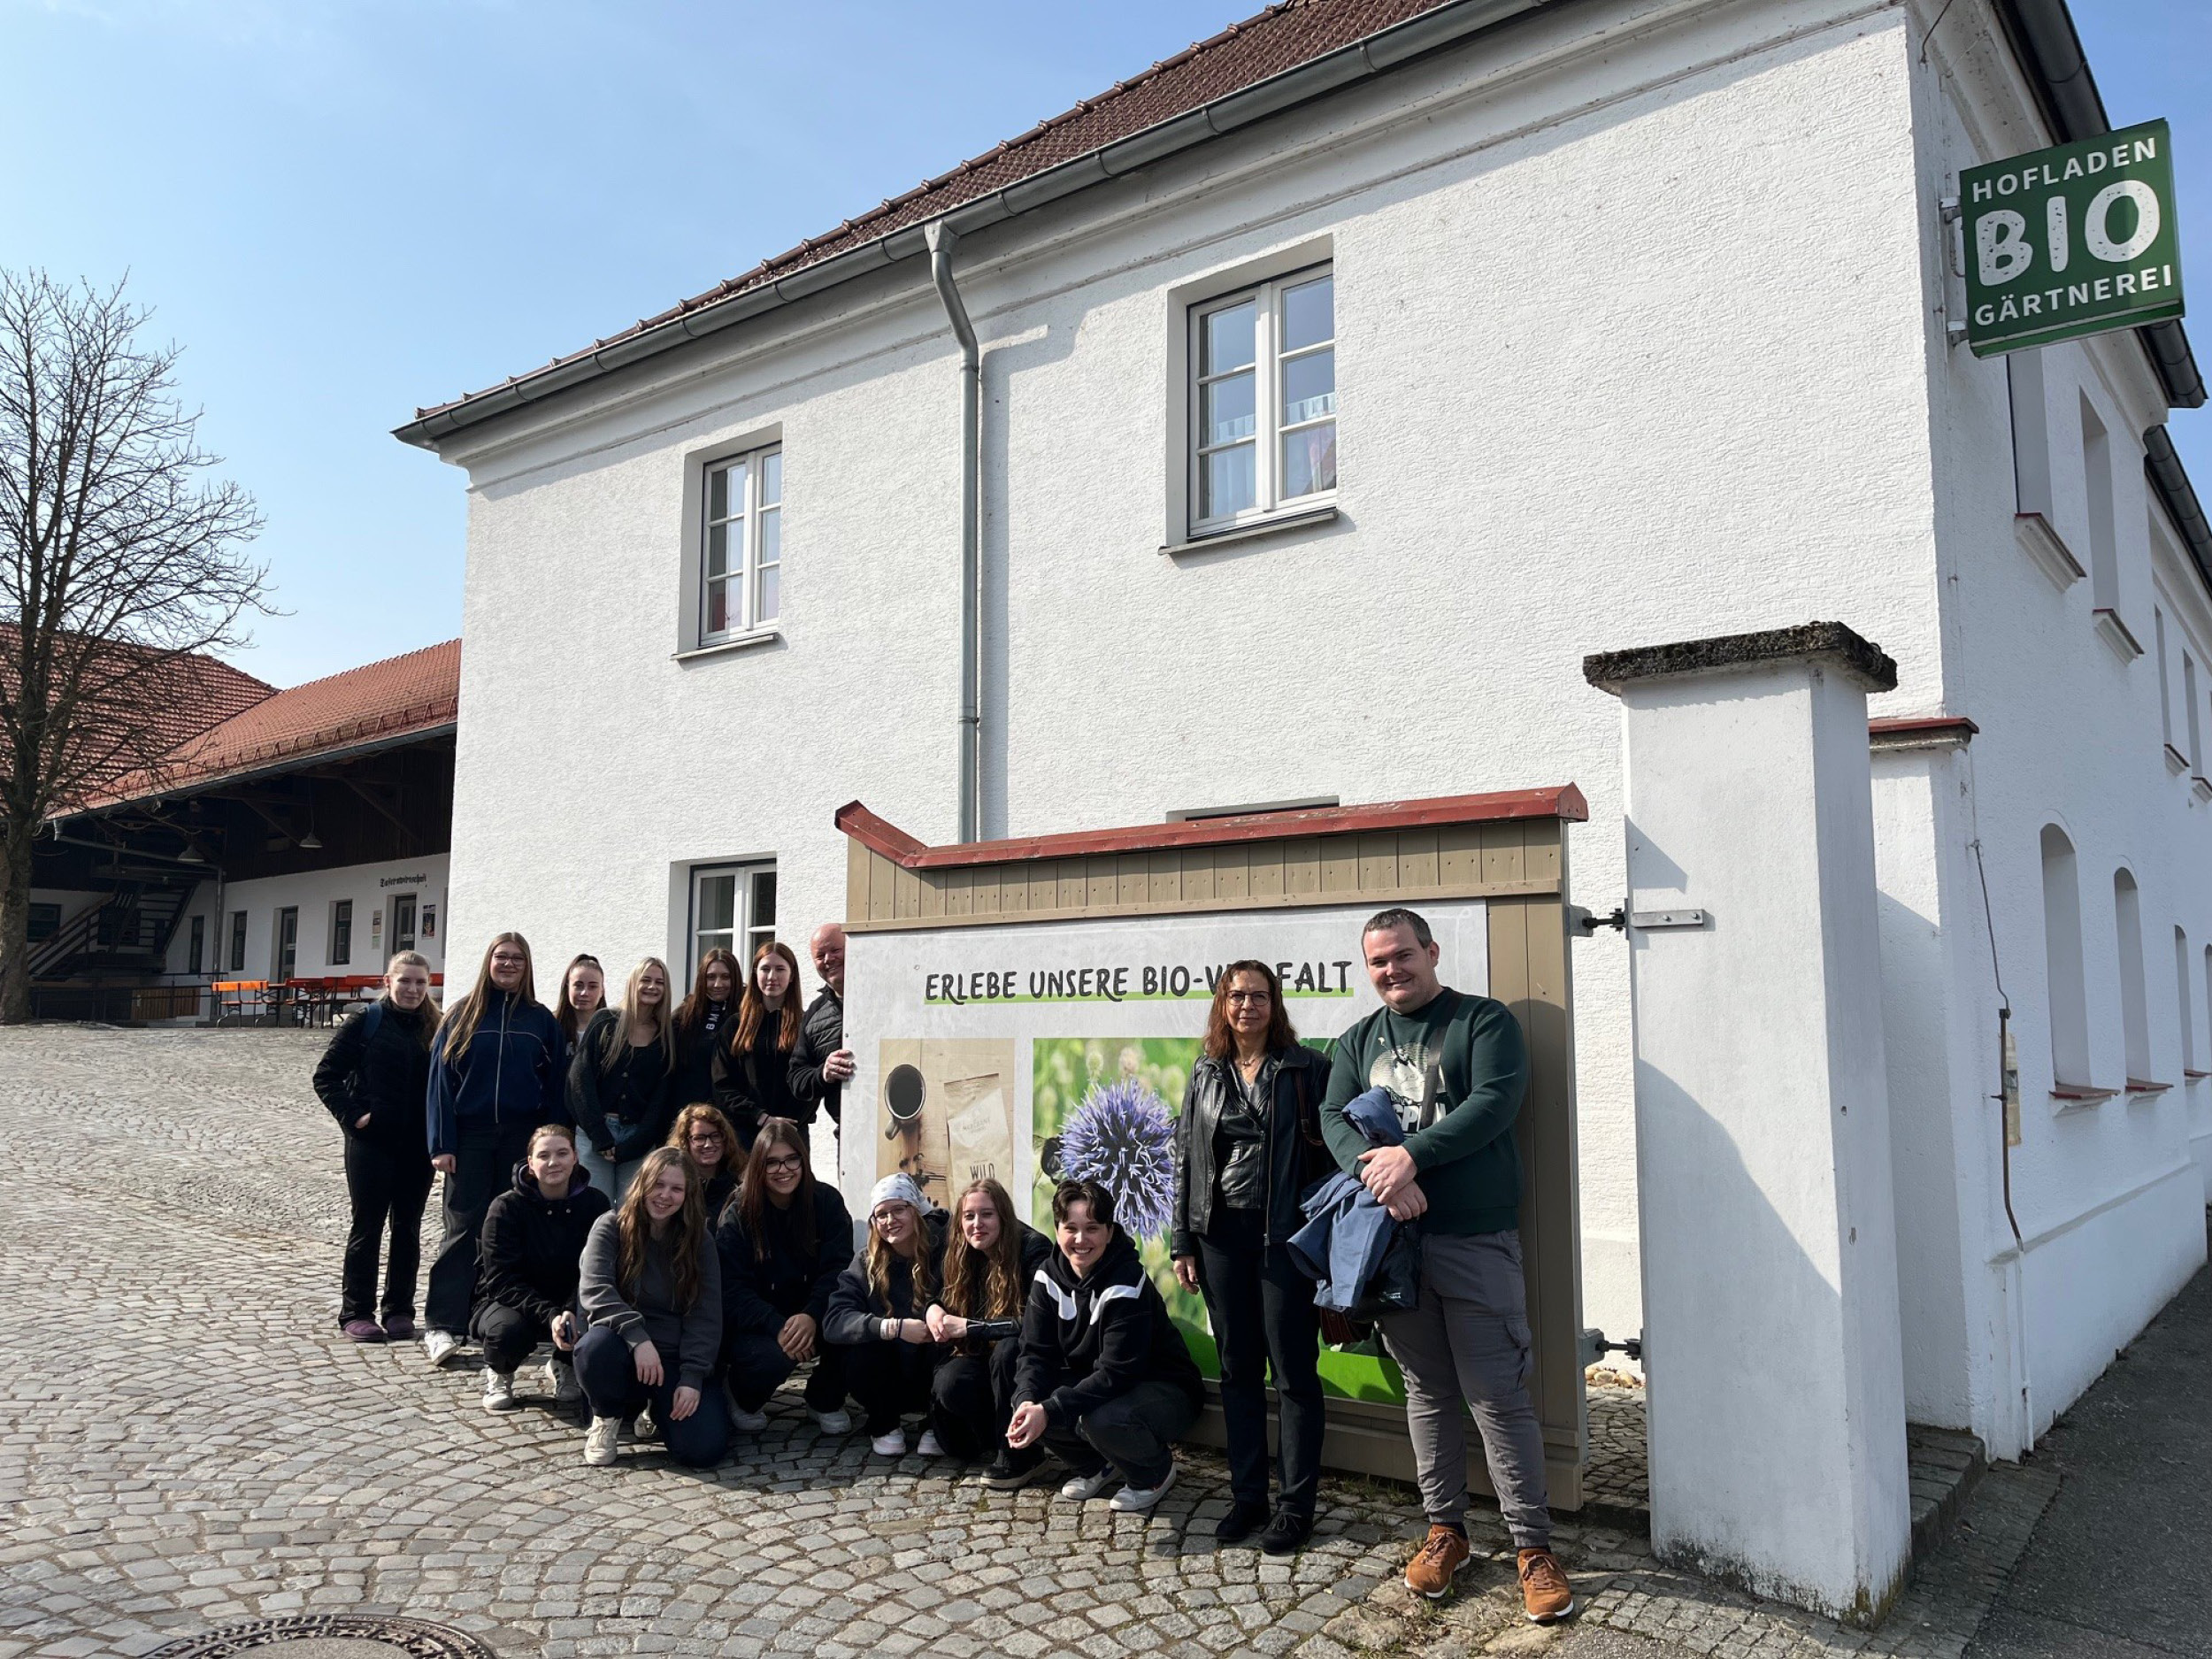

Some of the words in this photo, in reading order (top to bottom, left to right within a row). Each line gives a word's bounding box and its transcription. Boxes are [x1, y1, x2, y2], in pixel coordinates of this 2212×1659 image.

[1972, 137, 2156, 203] HOFLADEN
[1975, 180, 2161, 287] BIO
[1974, 265, 2172, 326] GÄRTNEREI
[926, 971, 1018, 1005] ERLEBE
[1029, 967, 1129, 1002] UNSERE
[1142, 961, 1352, 996] BIO-VFALT
